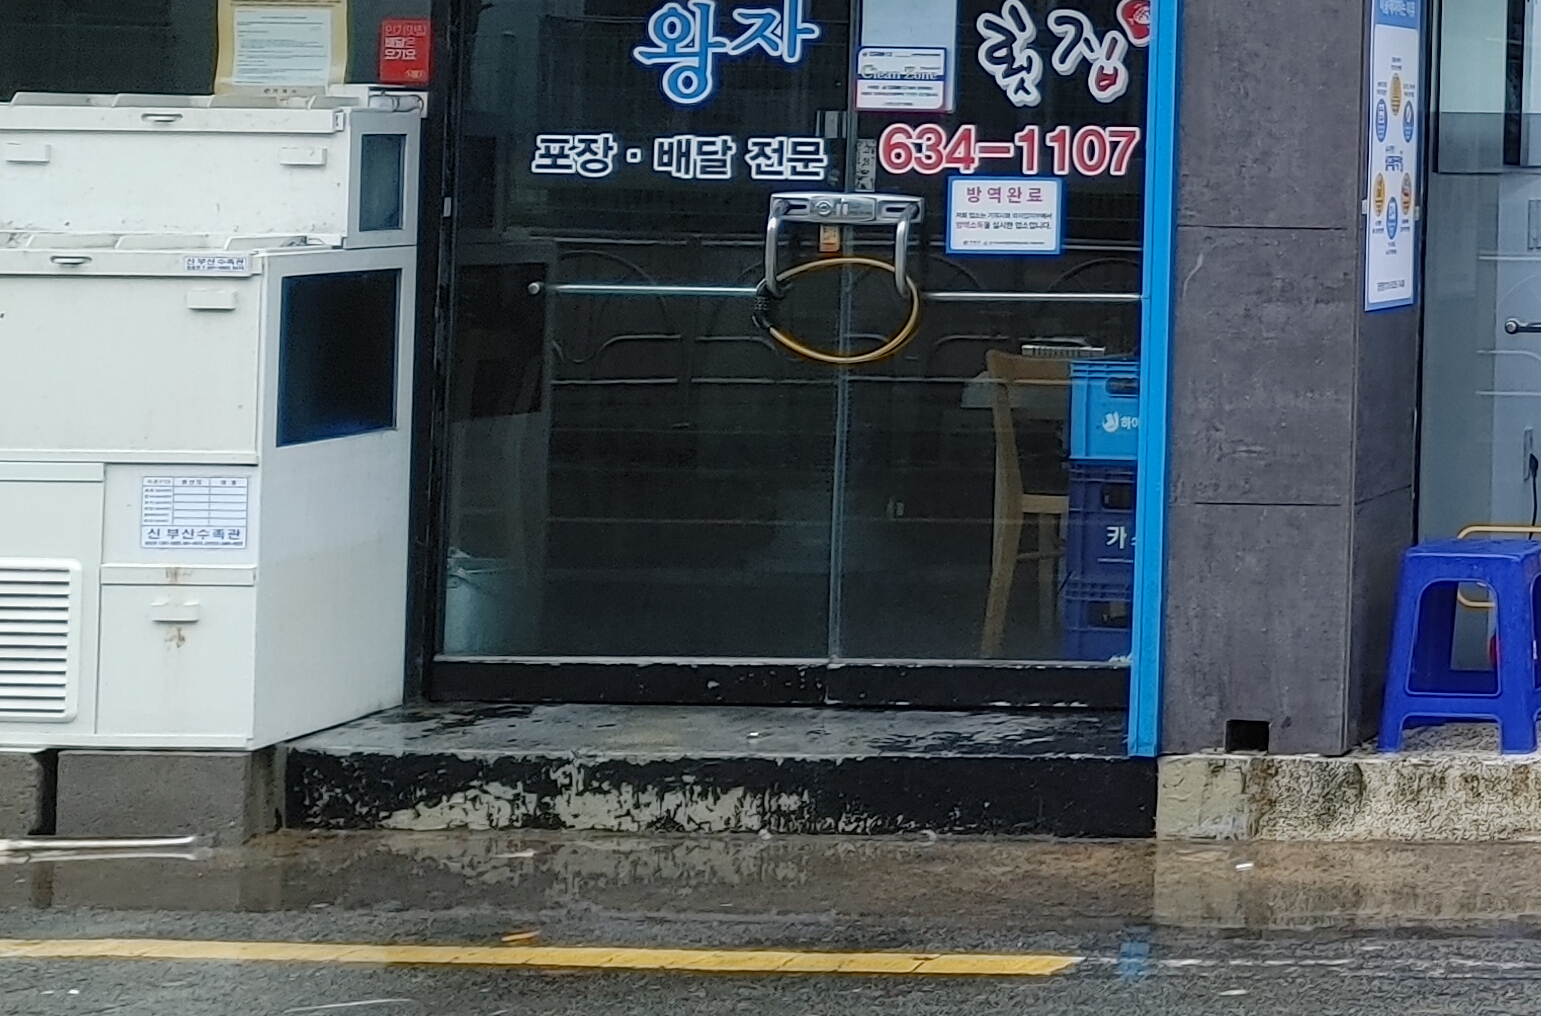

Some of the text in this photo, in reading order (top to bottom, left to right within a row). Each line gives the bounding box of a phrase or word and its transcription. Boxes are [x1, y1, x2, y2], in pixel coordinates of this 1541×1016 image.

[530, 133, 829, 181] 포장 배달 전문
[877, 122, 1141, 177] 634-1107
[966, 185, 1044, 204] 방역완료
